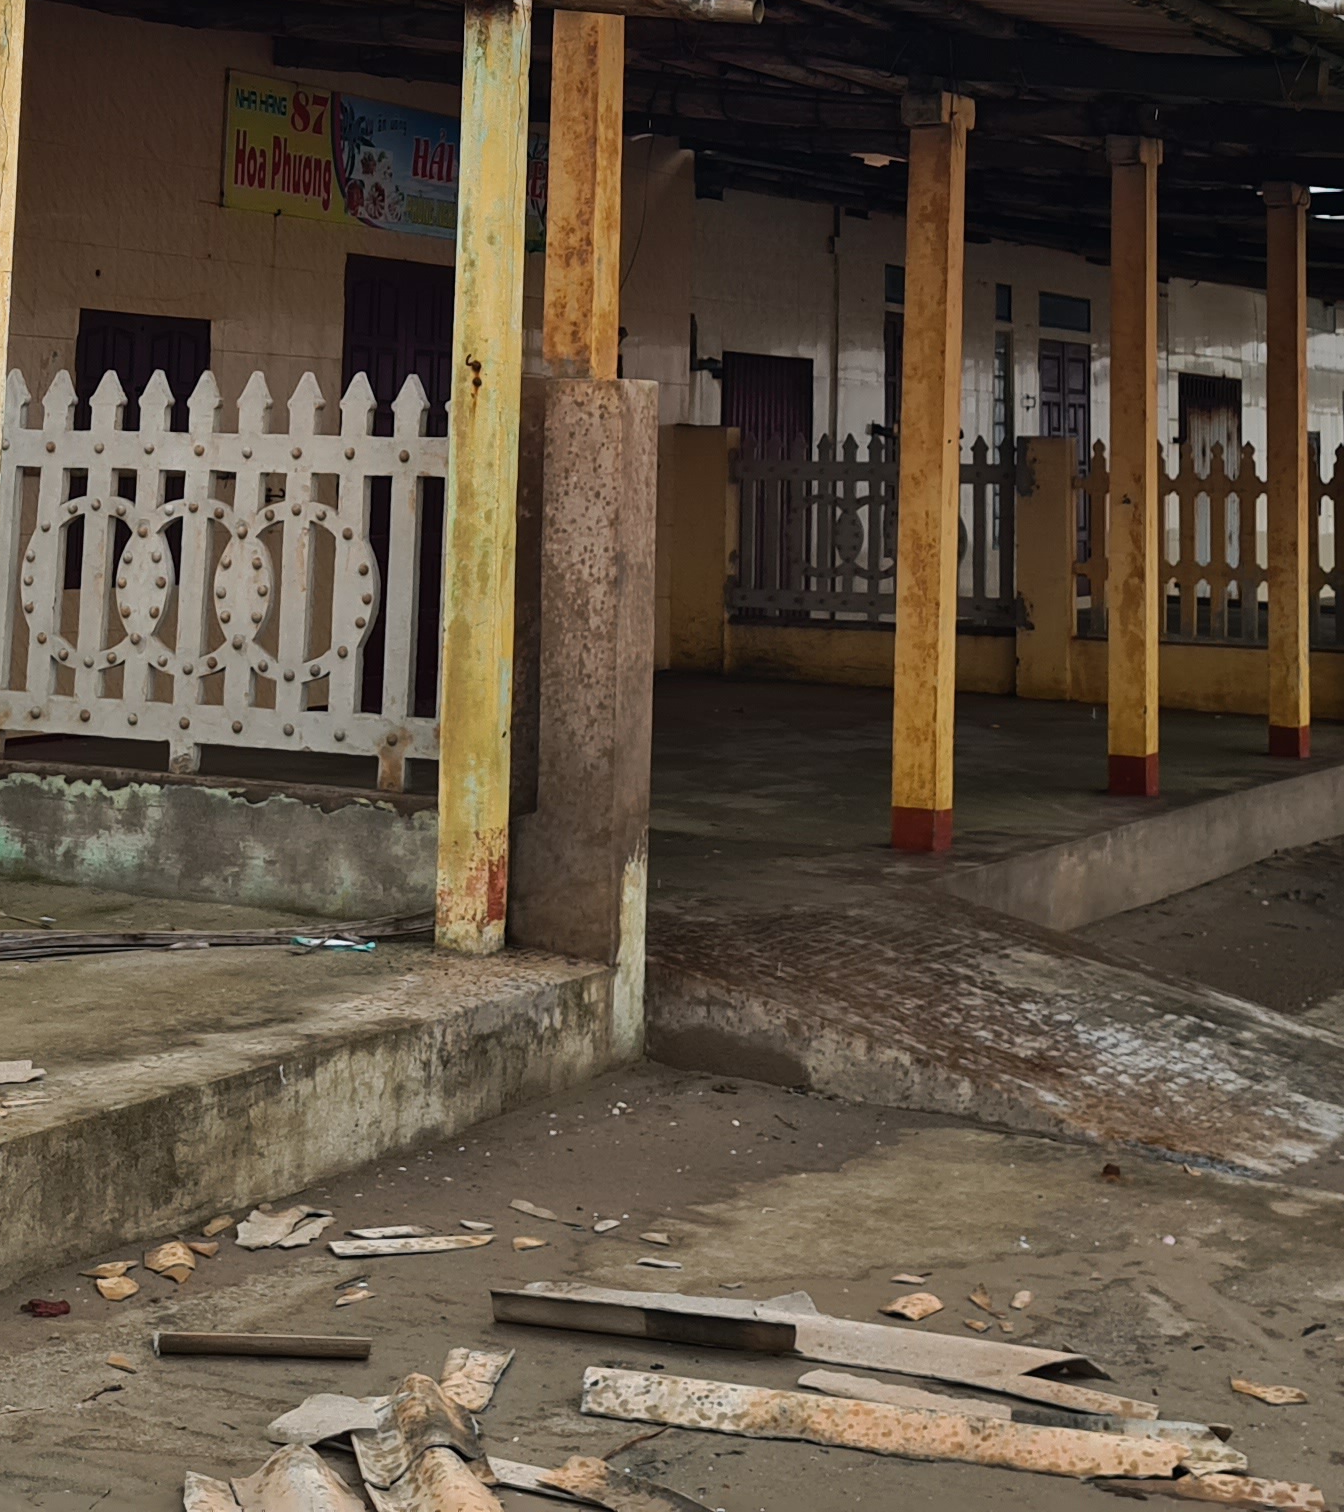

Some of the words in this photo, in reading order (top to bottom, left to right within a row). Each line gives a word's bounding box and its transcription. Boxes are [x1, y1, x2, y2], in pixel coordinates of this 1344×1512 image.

[291, 90, 330, 136] 87
[233, 129, 267, 195] Hoa
[412, 128, 456, 183] HẢI
